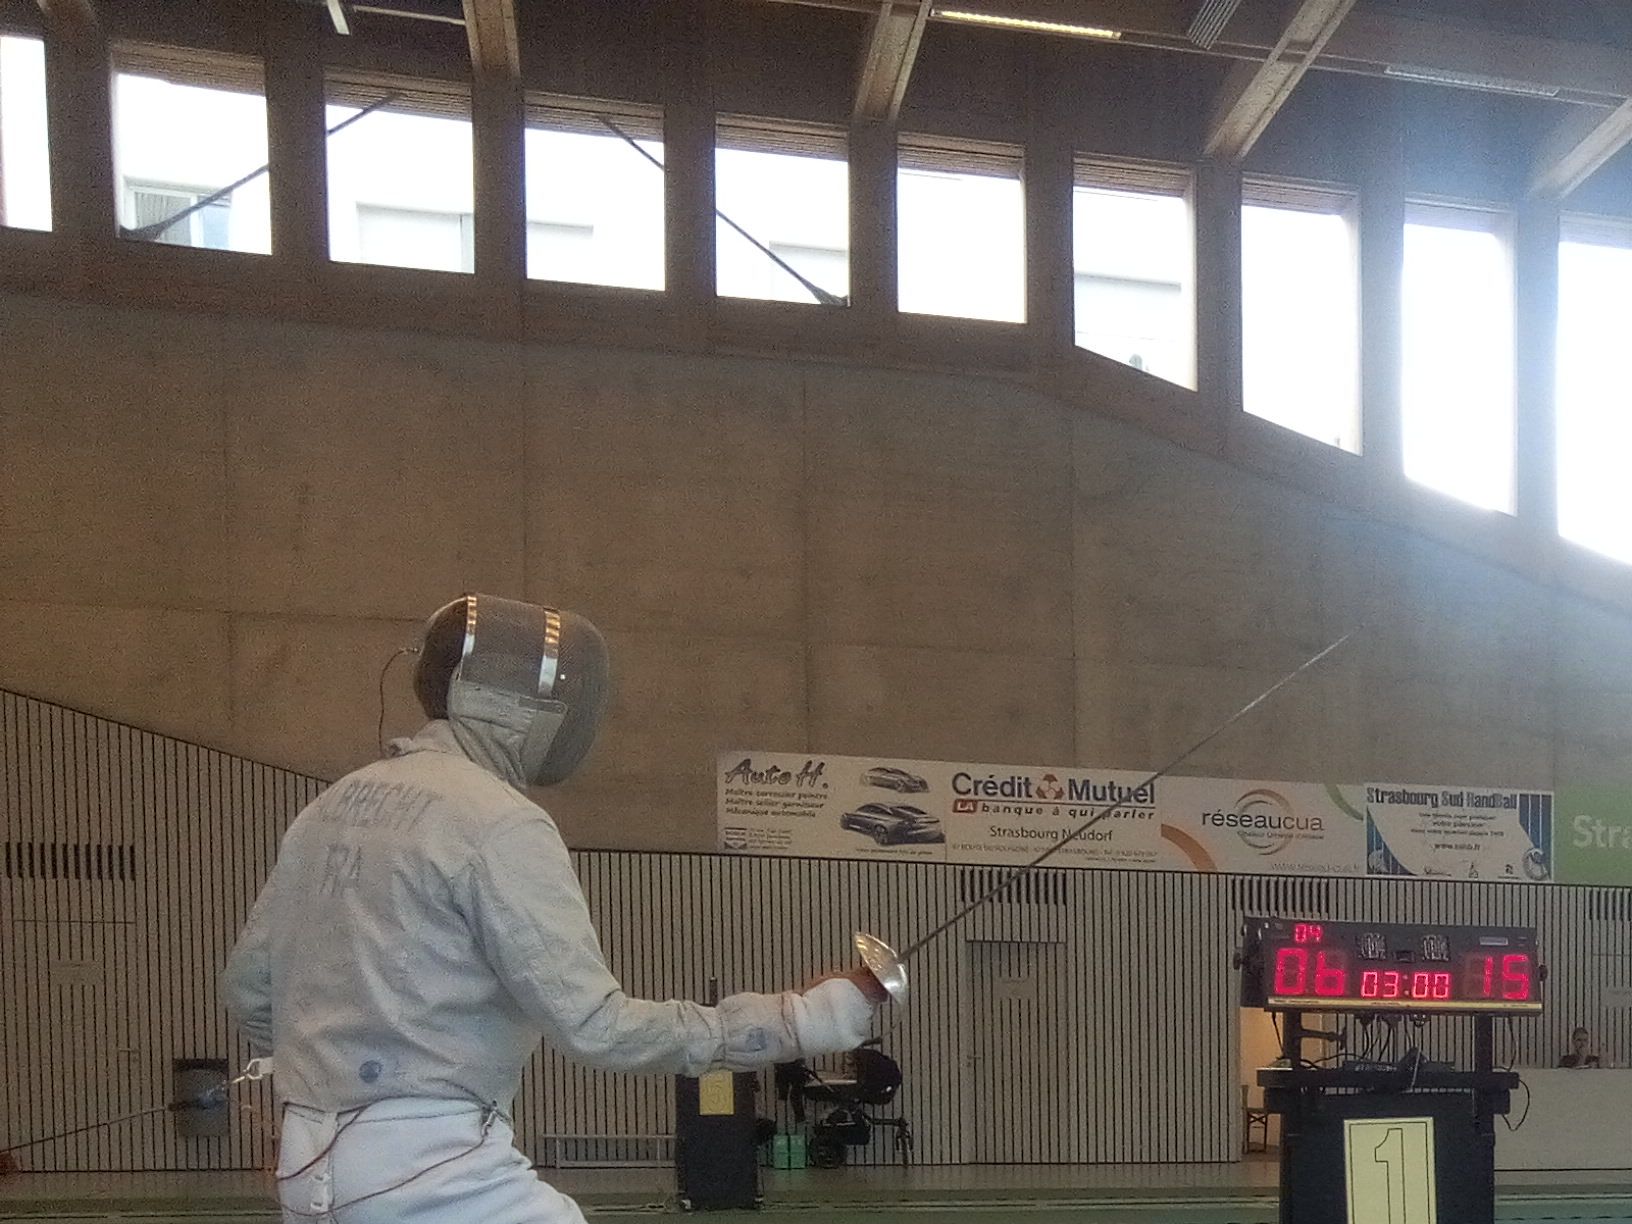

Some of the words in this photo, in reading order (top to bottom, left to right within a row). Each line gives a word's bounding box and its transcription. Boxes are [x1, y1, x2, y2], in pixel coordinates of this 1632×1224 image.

[725, 758, 791, 786] Auto
[951, 772, 1033, 799] Crédit
[1068, 778, 1156, 804] Mutuel
[1367, 787, 1438, 808] Strasbourg
[1441, 791, 1463, 807] Sud
[955, 801, 976, 812] LA
[982, 802, 1043, 816] banque
[1052, 804, 1060, 816] à
[1069, 806, 1095, 819] qui
[1102, 808, 1155, 820] parler
[1202, 809, 1325, 831] réseaucua
[990, 825, 1058, 841] Strasbourg
[1295, 923, 1322, 943] 04
[1275, 948, 1344, 995] 06
[1361, 971, 1450, 998] 03:00
[1484, 954, 1530, 999] 15
